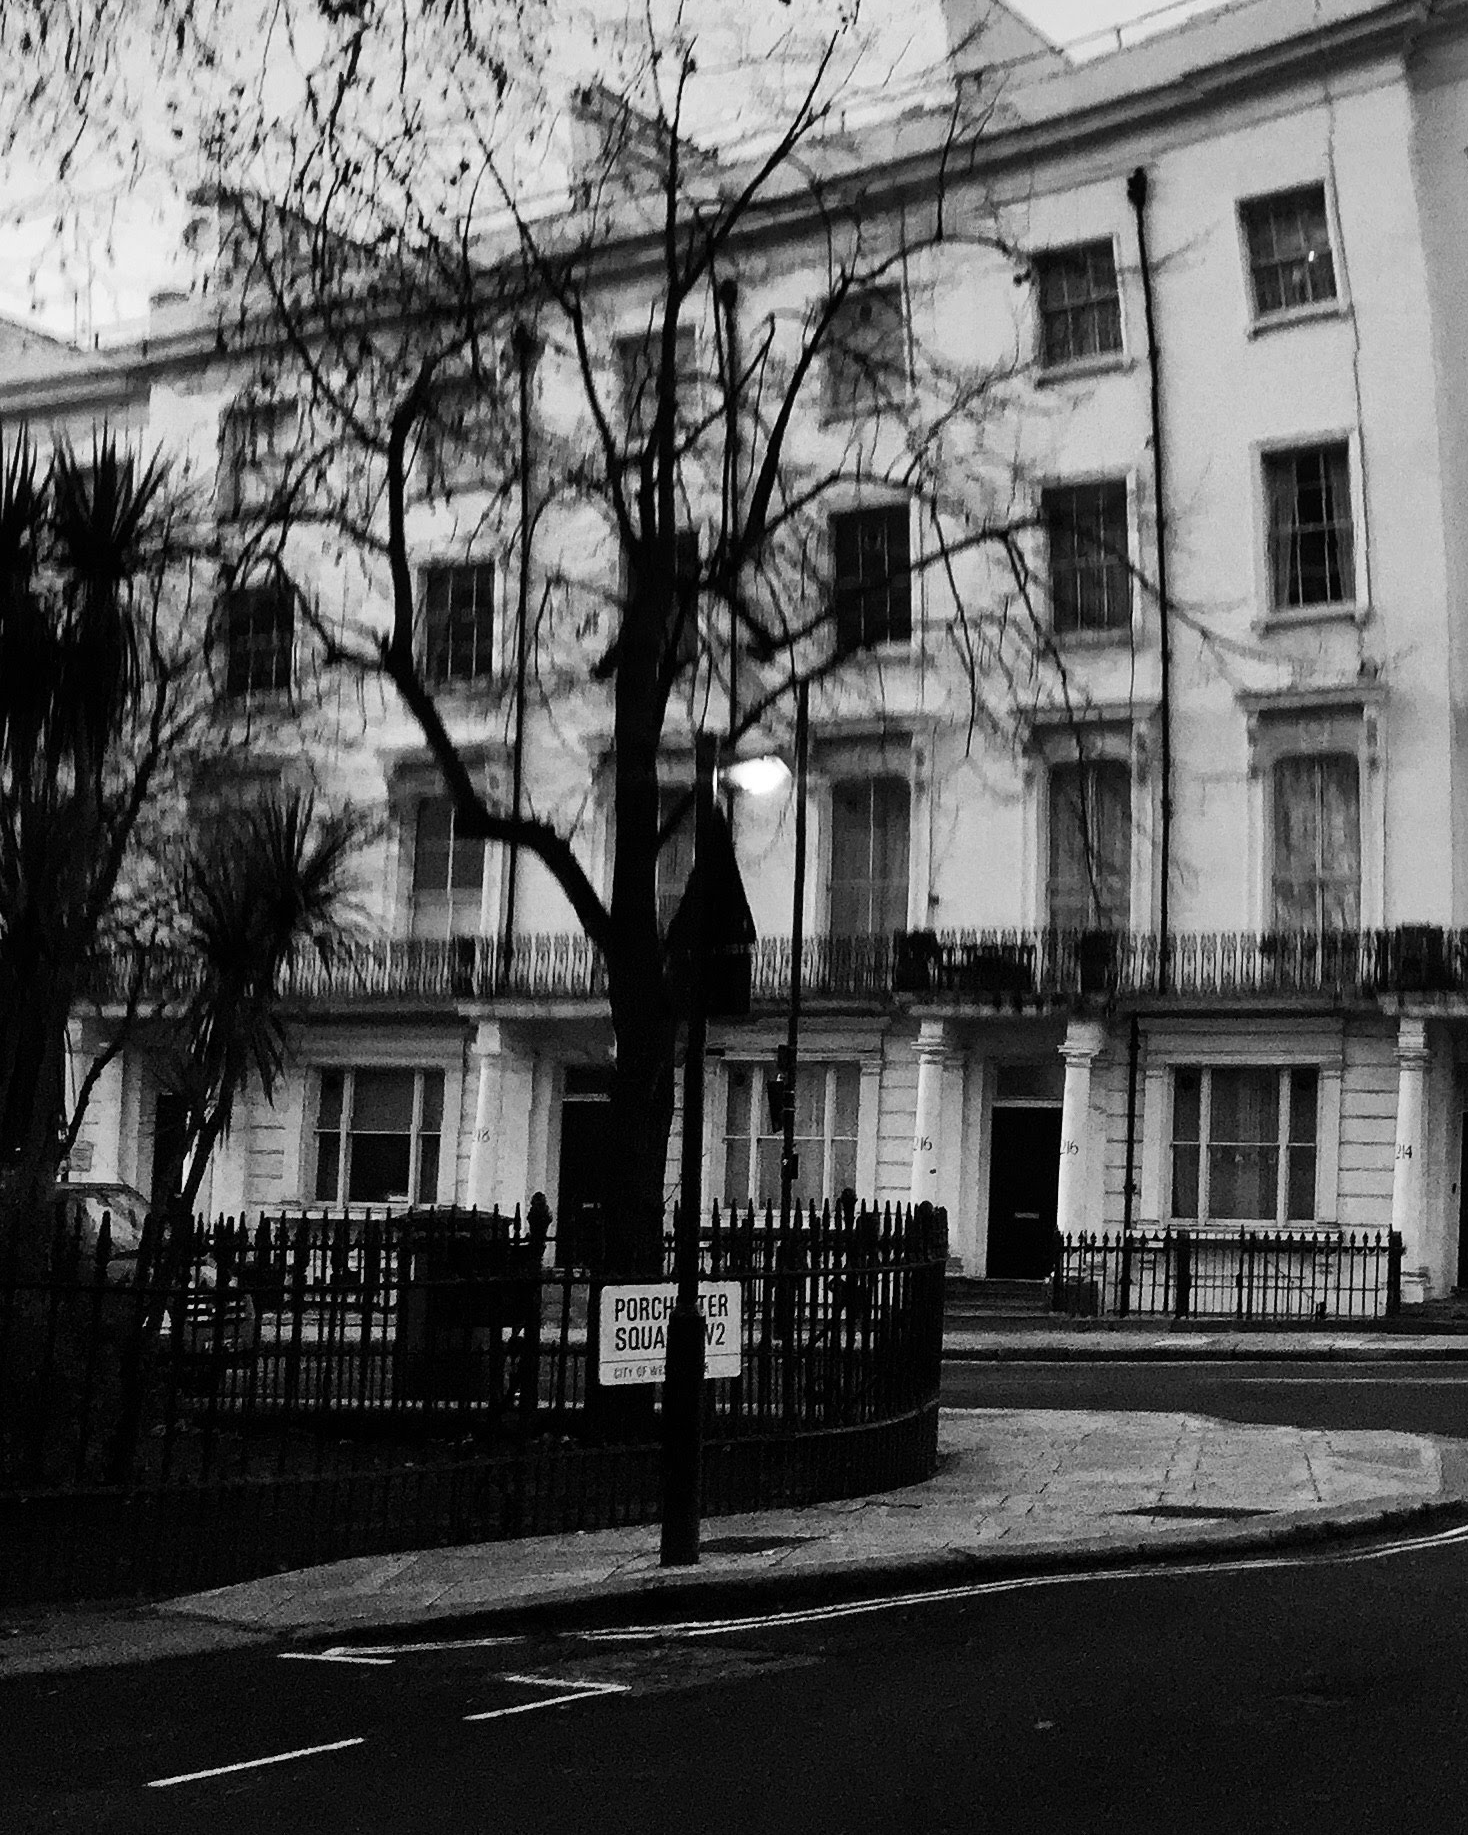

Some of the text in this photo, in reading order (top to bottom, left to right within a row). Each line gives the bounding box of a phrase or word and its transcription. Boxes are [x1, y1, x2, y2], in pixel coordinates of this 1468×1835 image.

[913, 1136, 932, 1151] 216
[1060, 1140, 1079, 1155] 216
[1395, 1144, 1413, 1159] 214
[615, 1294, 728, 1322] PORCHTER
[615, 1325, 668, 1351] SQUA
